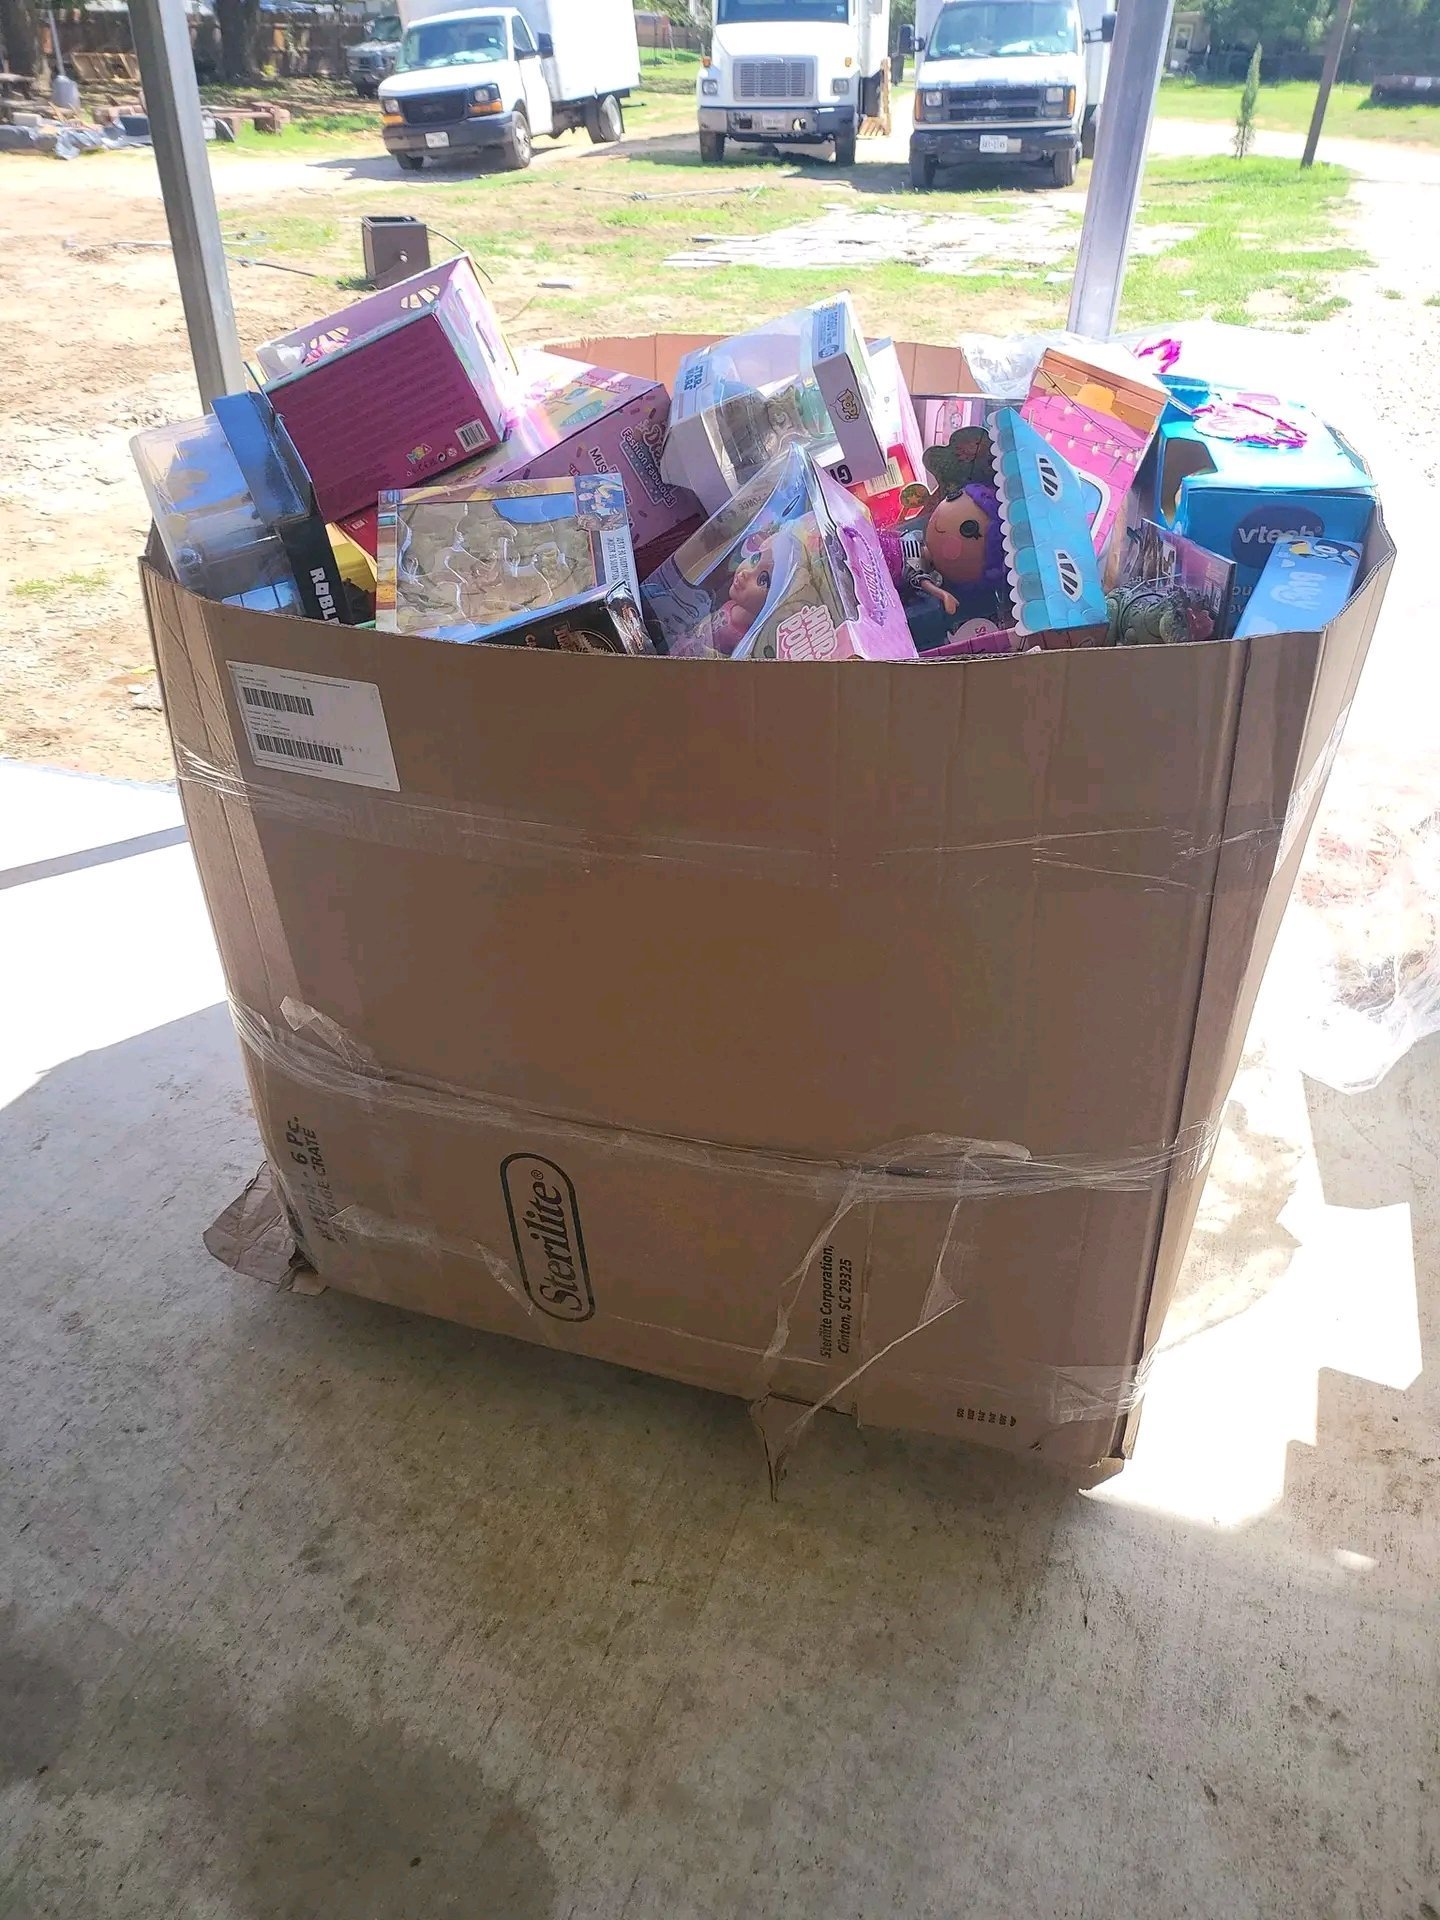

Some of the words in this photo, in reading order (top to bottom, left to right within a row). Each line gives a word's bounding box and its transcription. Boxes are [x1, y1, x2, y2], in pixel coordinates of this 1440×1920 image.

[838, 388, 859, 420] POP!
[621, 428, 649, 466] Fashion
[645, 463, 676, 506] Fabulous!
[801, 606, 836, 656] HAIR
[290, 1151, 308, 1165] 6
[302, 1127, 326, 1177] CRATE
[819, 1245, 835, 1316] Corporation,
[839, 1258, 852, 1294] 29325
[838, 1296, 852, 1312] SC
[819, 1317, 833, 1358] Sterilite
[837, 1313, 852, 1354] Clinton,
